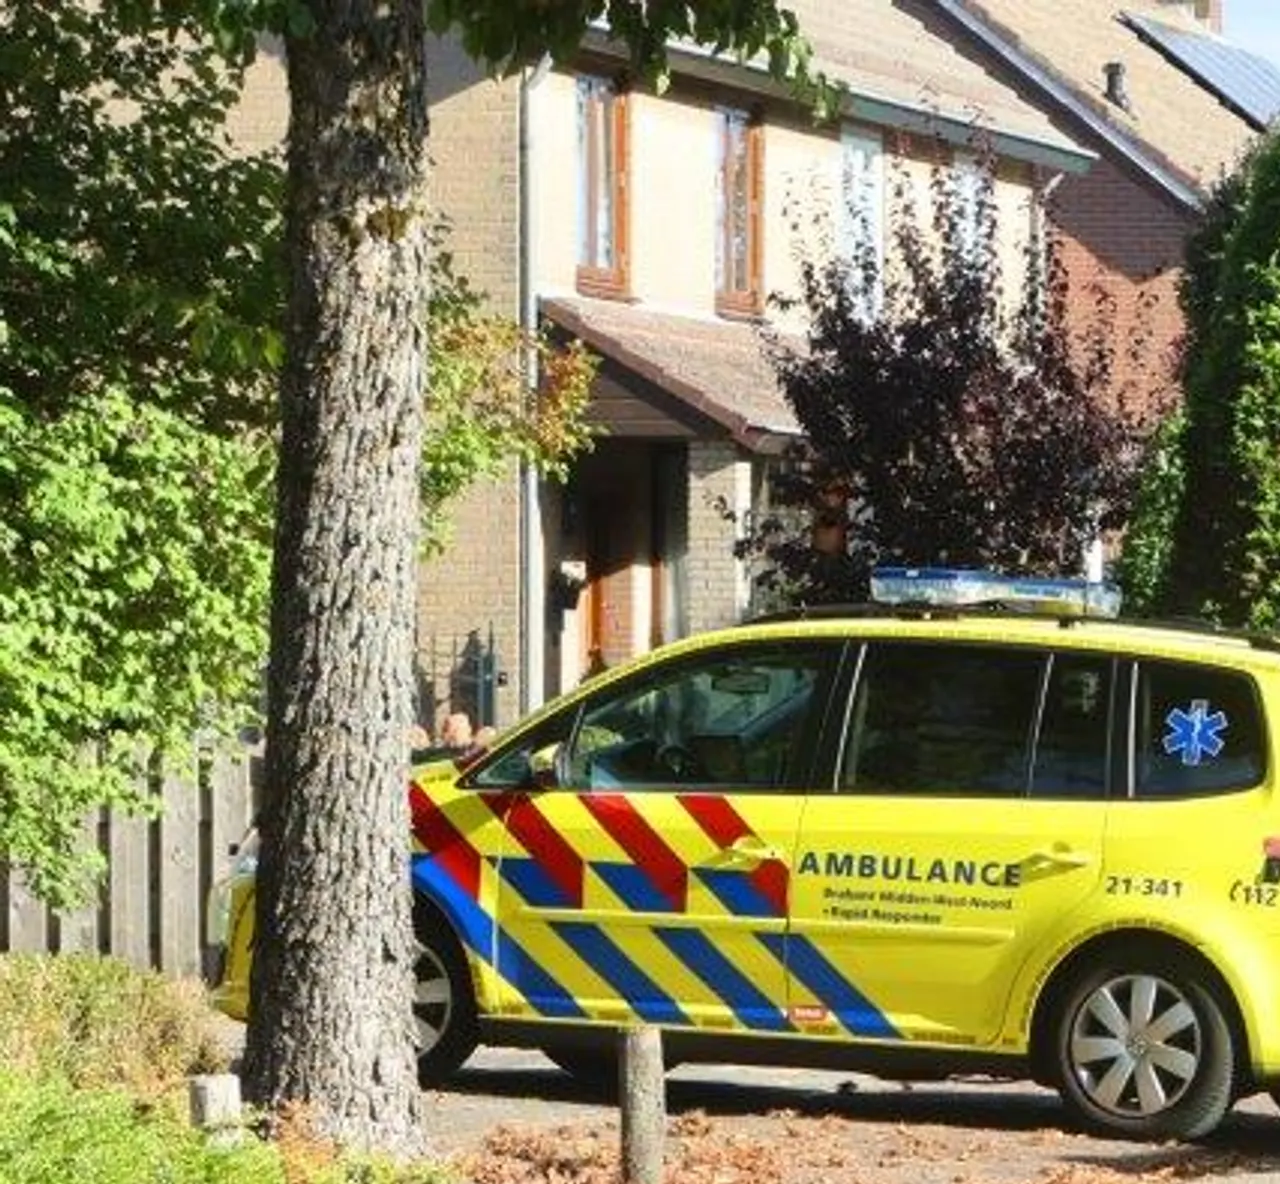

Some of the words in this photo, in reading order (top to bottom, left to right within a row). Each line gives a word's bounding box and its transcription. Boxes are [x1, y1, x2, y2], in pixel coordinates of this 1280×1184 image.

[798, 851, 1022, 887] AMBULANCE
[1106, 876, 1182, 898] 21-341
[1243, 885, 1278, 907] 112
